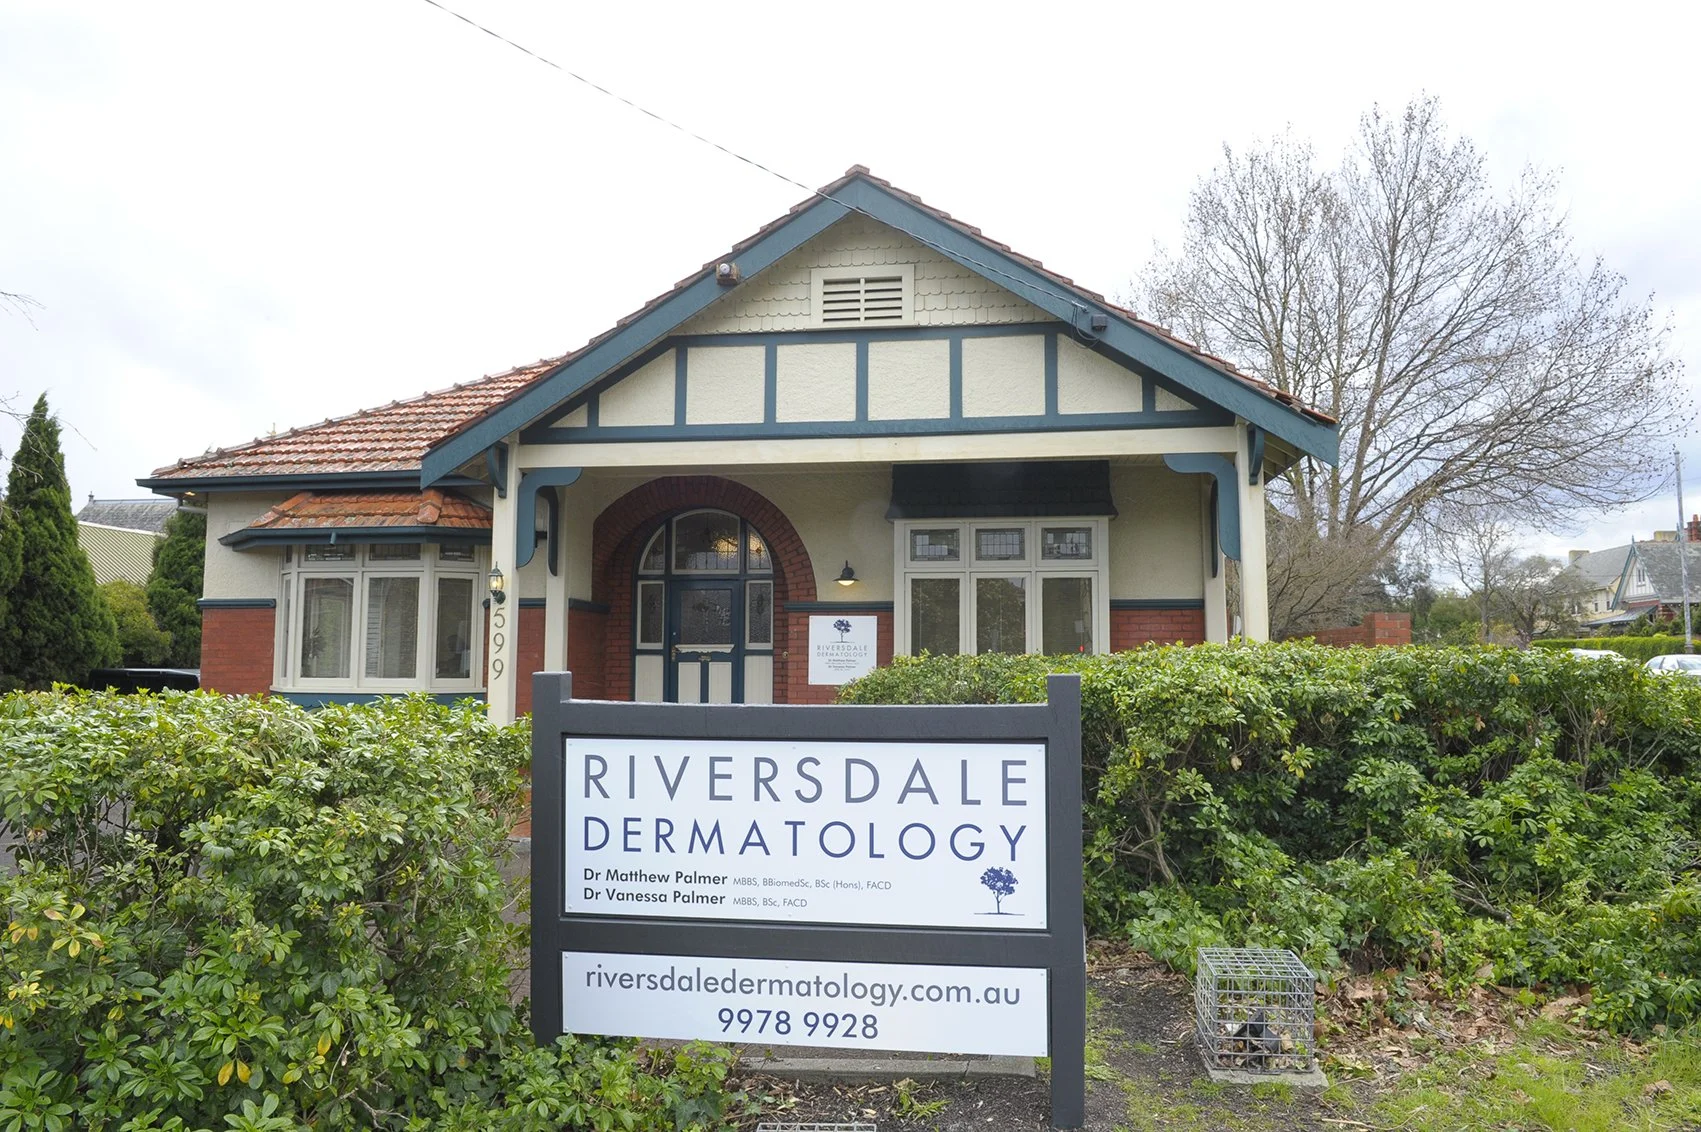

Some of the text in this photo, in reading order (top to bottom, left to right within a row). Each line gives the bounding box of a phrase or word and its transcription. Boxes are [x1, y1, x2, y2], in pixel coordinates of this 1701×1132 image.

[492, 607, 505, 680] 599
[583, 754, 1028, 807] RIVERSDALE
[583, 815, 1027, 862] DERMATOLOGY
[583, 867, 892, 890] Dr Matthew Palmer MBBS, BBiomedSc, BSc (Hons), FACD
[583, 887, 808, 908] Dr Vanessa Palmer MBBS, BSc, FACD
[585, 963, 1020, 1007] riversdaledermatology.com.au
[717, 1007, 879, 1040] 9978 9928
